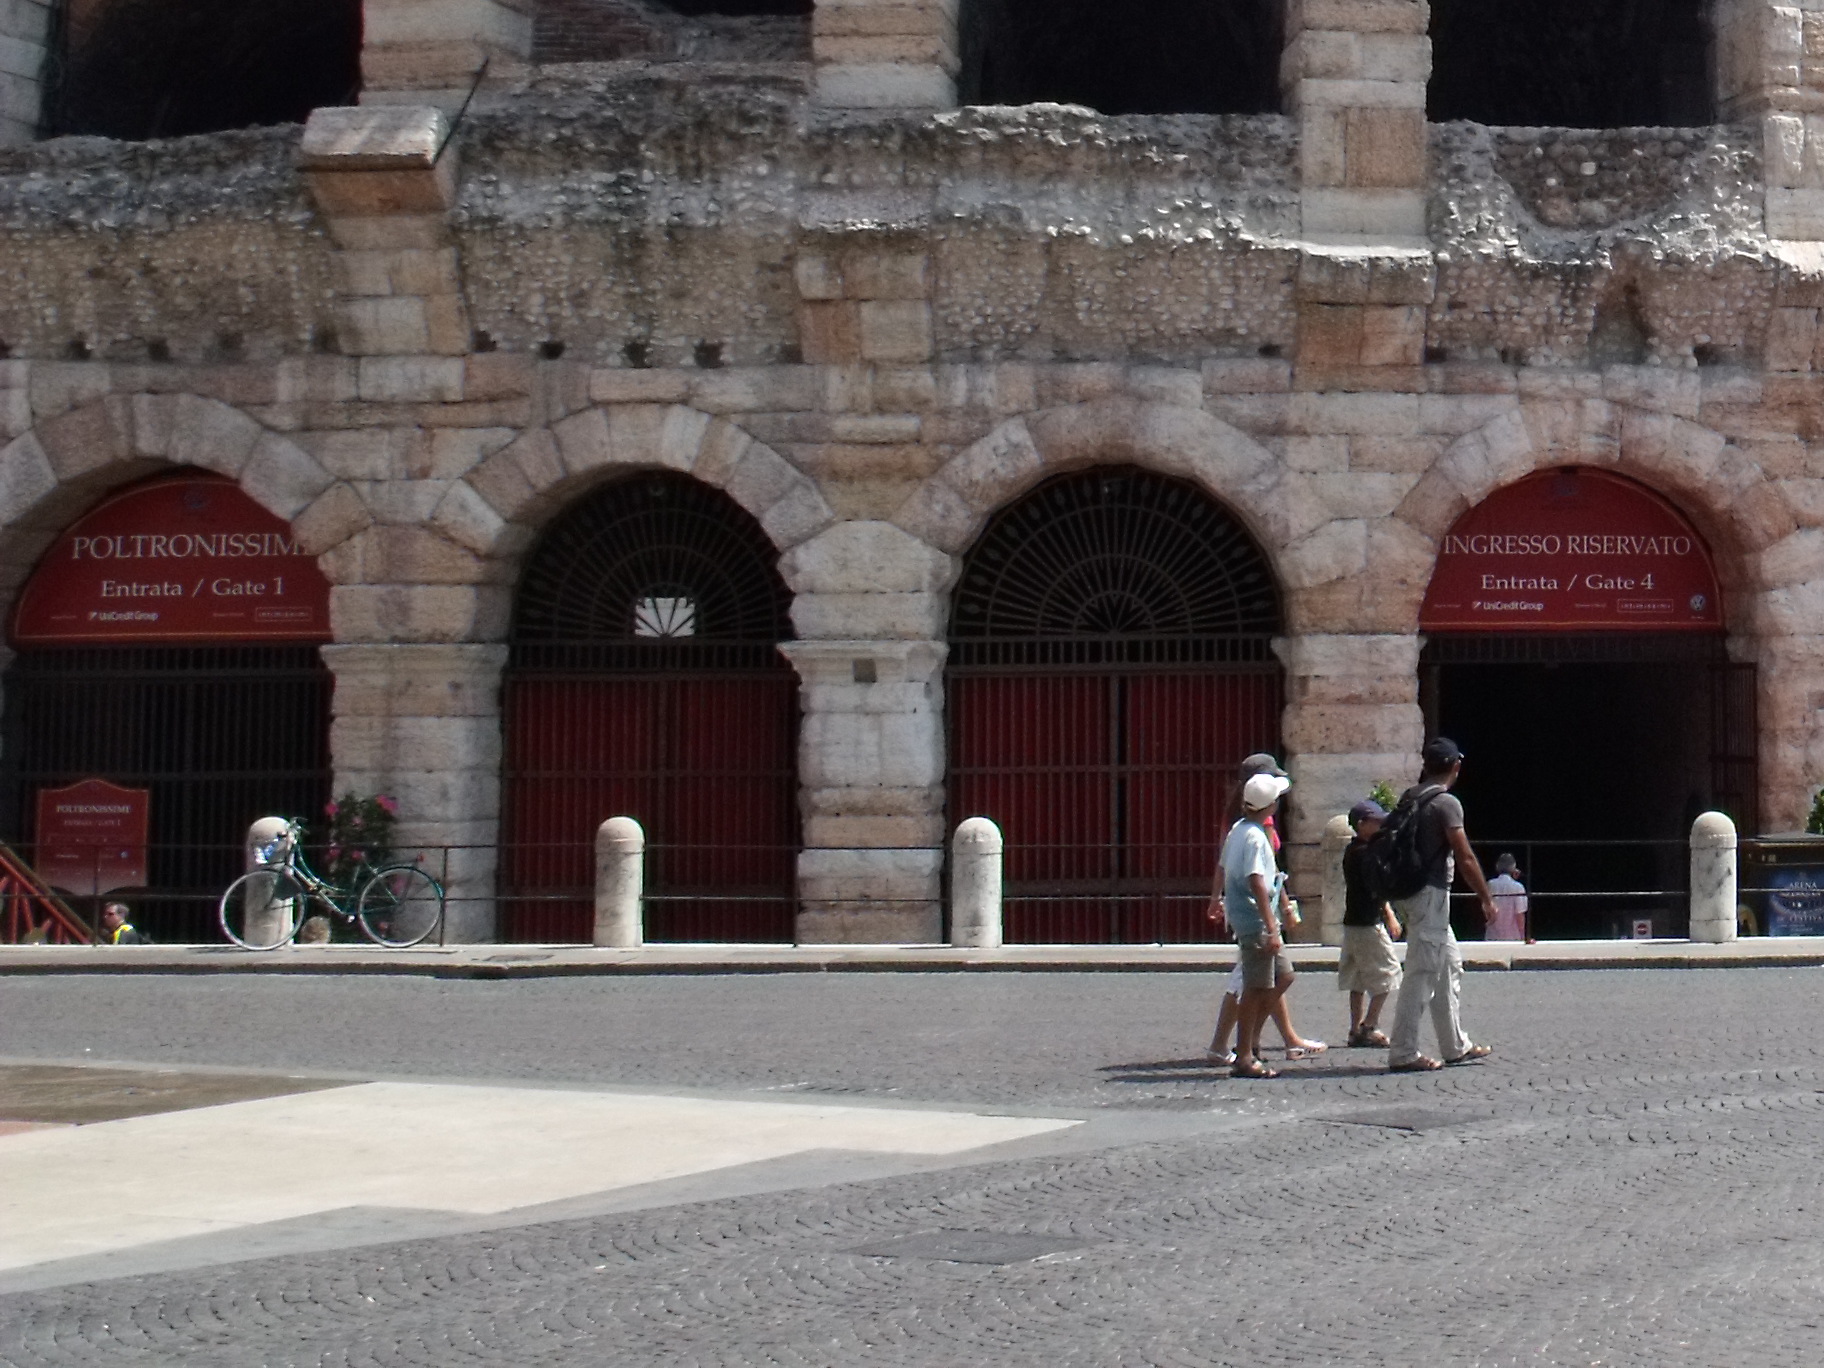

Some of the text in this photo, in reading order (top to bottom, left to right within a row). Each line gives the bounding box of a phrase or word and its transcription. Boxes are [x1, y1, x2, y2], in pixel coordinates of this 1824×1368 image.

[72, 533, 311, 560] POLTRONISSIM
[1444, 534, 1691, 555] INGRESSO RISERVATO
[101, 580, 182, 598] Entrata
[211, 578, 266, 596] Gate
[273, 577, 285, 595] 1
[1481, 574, 1558, 590] Entrata
[1585, 574, 1635, 590] Gate
[1640, 573, 1655, 590] 4
